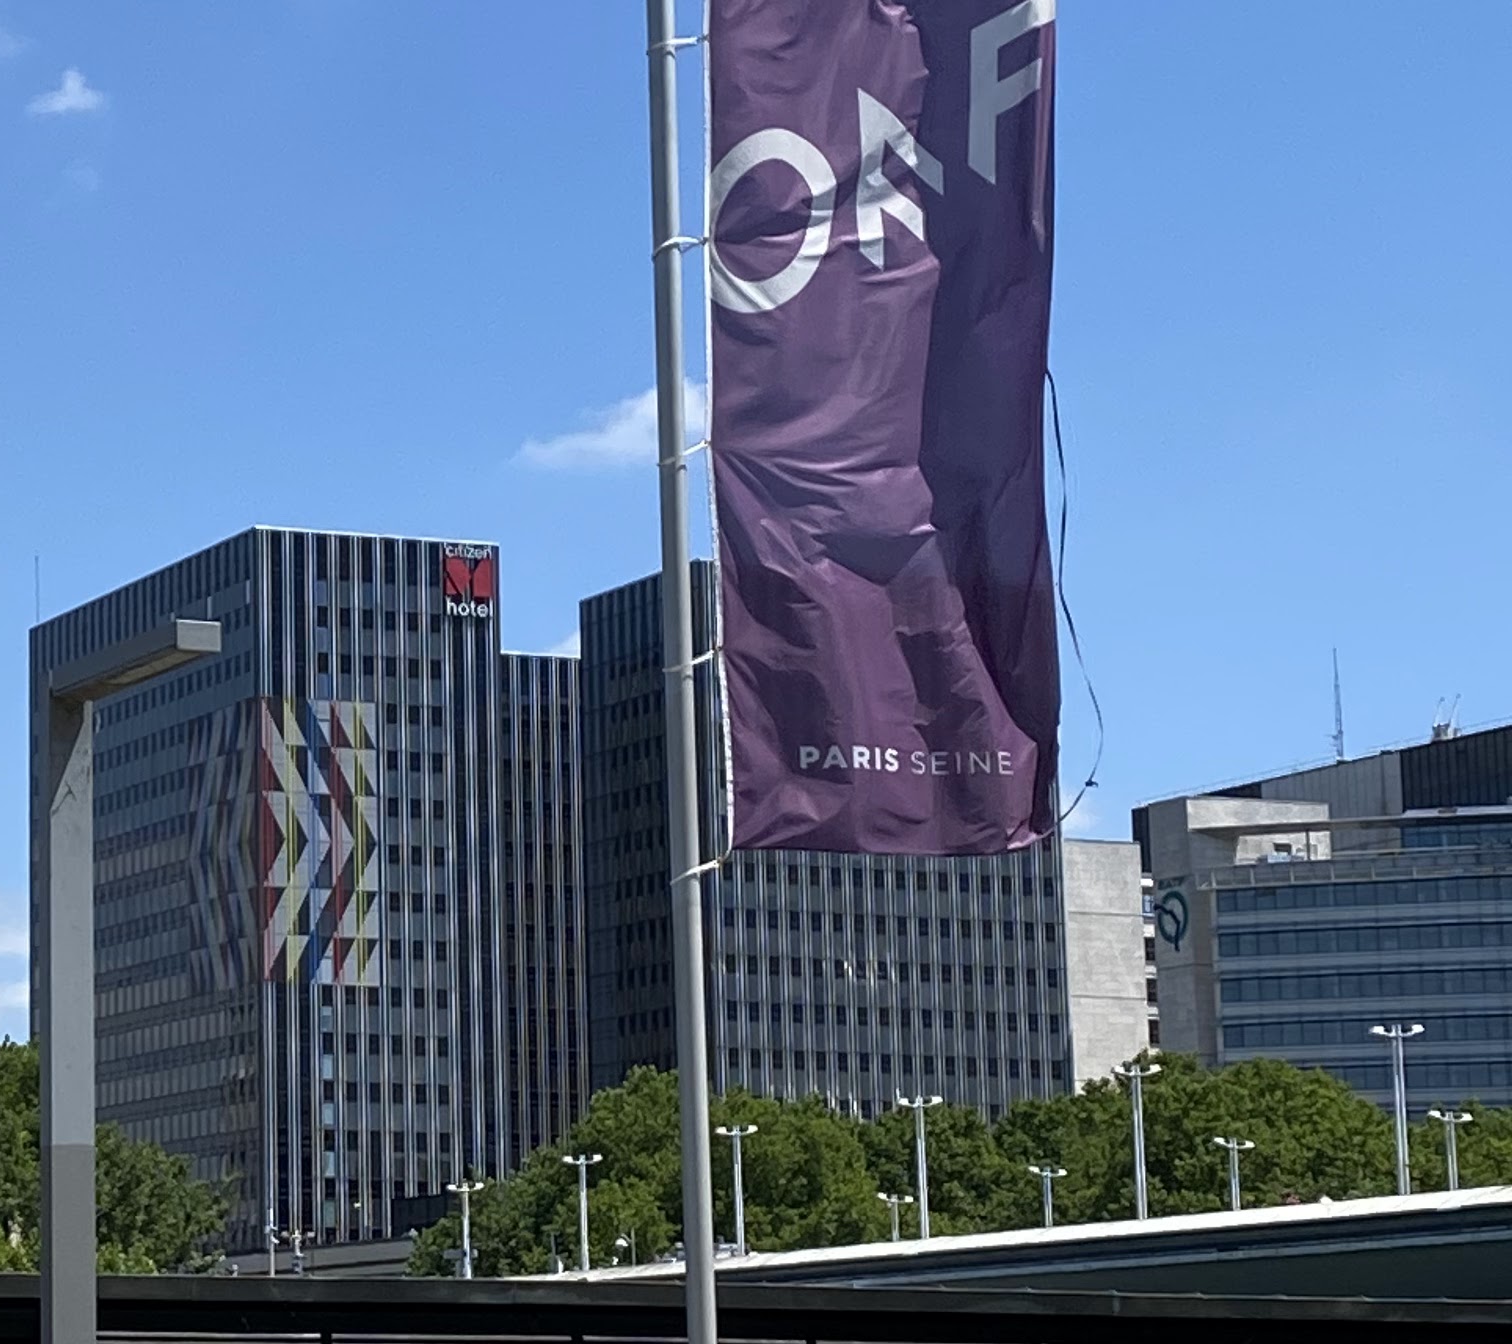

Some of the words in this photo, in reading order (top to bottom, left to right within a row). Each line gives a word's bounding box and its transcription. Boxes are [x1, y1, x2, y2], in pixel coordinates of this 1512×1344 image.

[444, 543, 492, 560] citizen
[445, 595, 493, 617] hotel
[799, 745, 899, 772] PARIS
[910, 750, 1015, 776] SEINE
